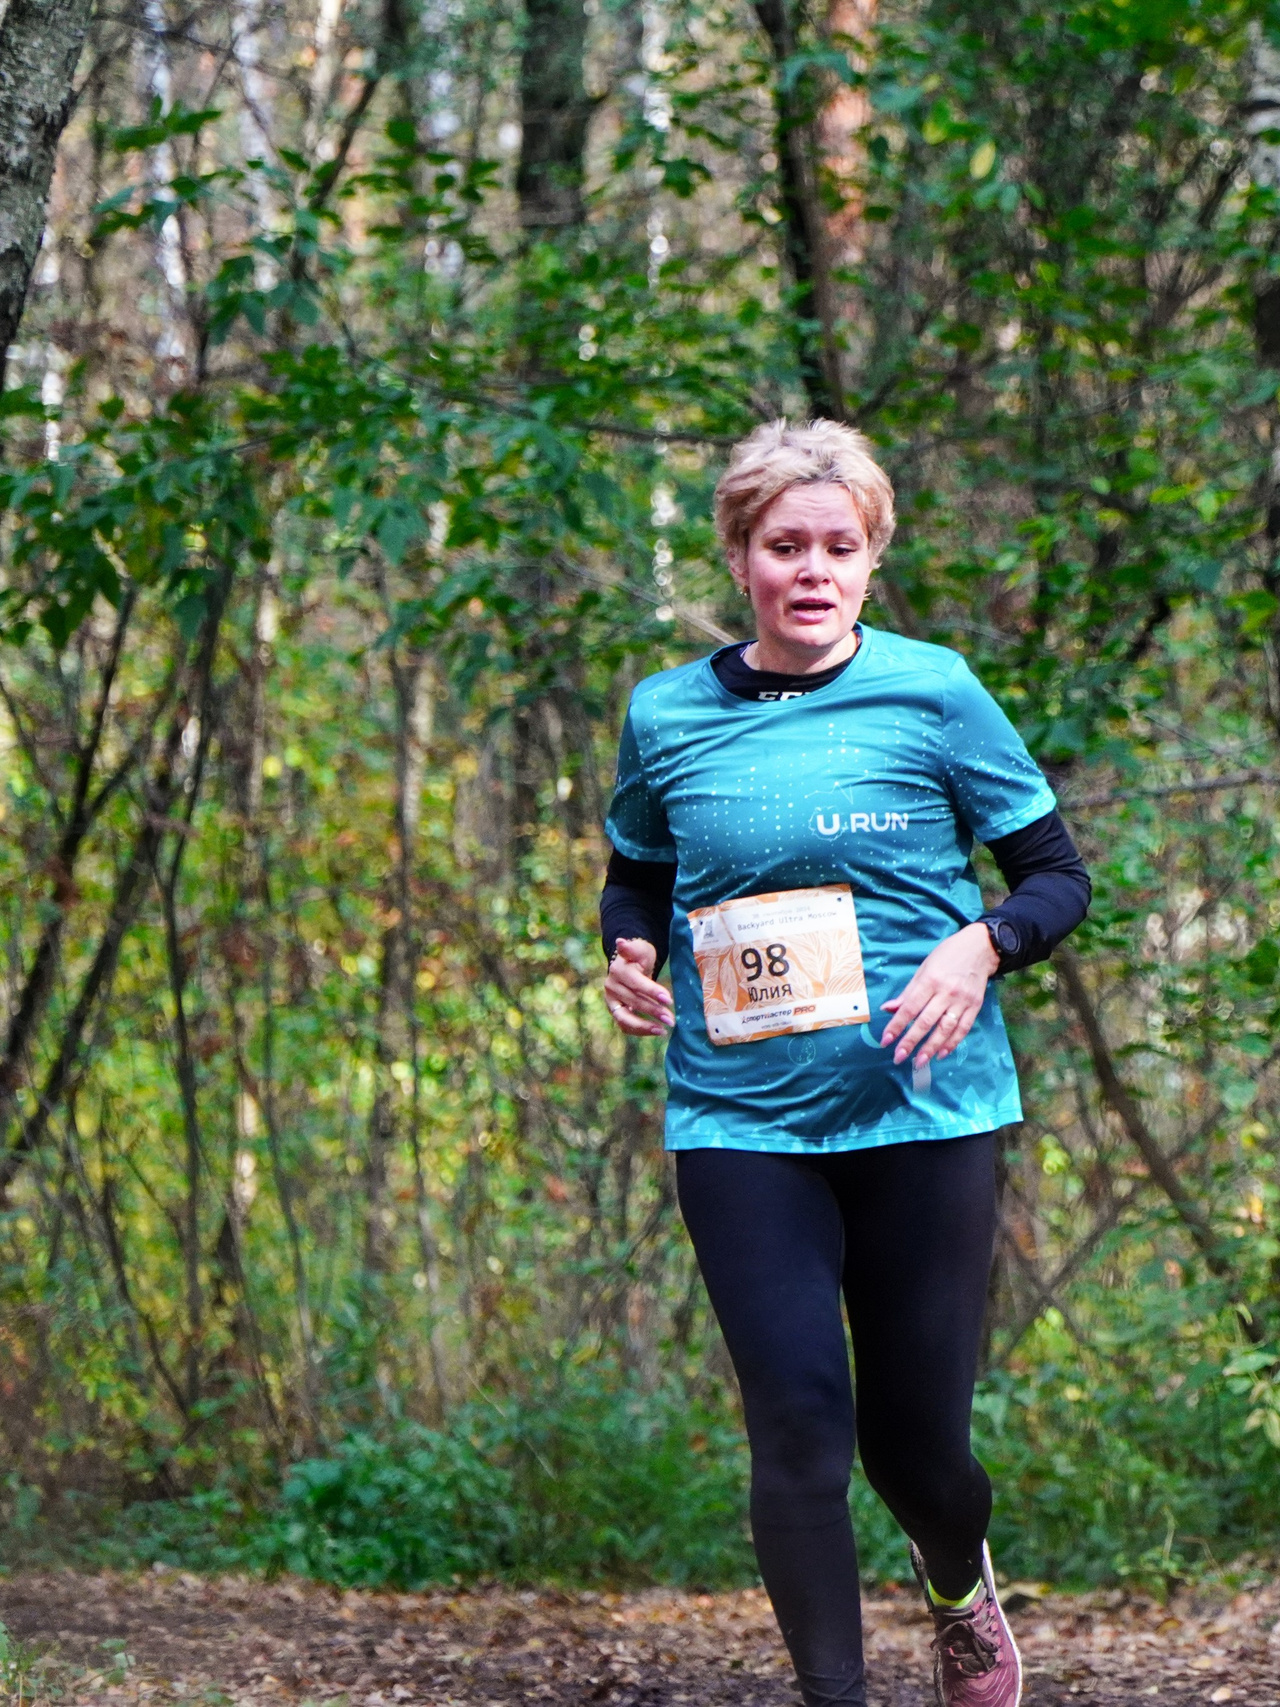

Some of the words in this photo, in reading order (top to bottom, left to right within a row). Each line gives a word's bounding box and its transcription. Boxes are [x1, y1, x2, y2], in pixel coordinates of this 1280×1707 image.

[816, 813, 841, 835] U
[850, 811, 909, 834] RUN
[737, 917, 775, 932] Backyard
[778, 912, 804, 925] Ultra
[807, 911, 837, 920] Moscow
[741, 943, 790, 982] 98
[748, 983, 792, 1003] Юлия
[794, 1004, 816, 1016] PRO
